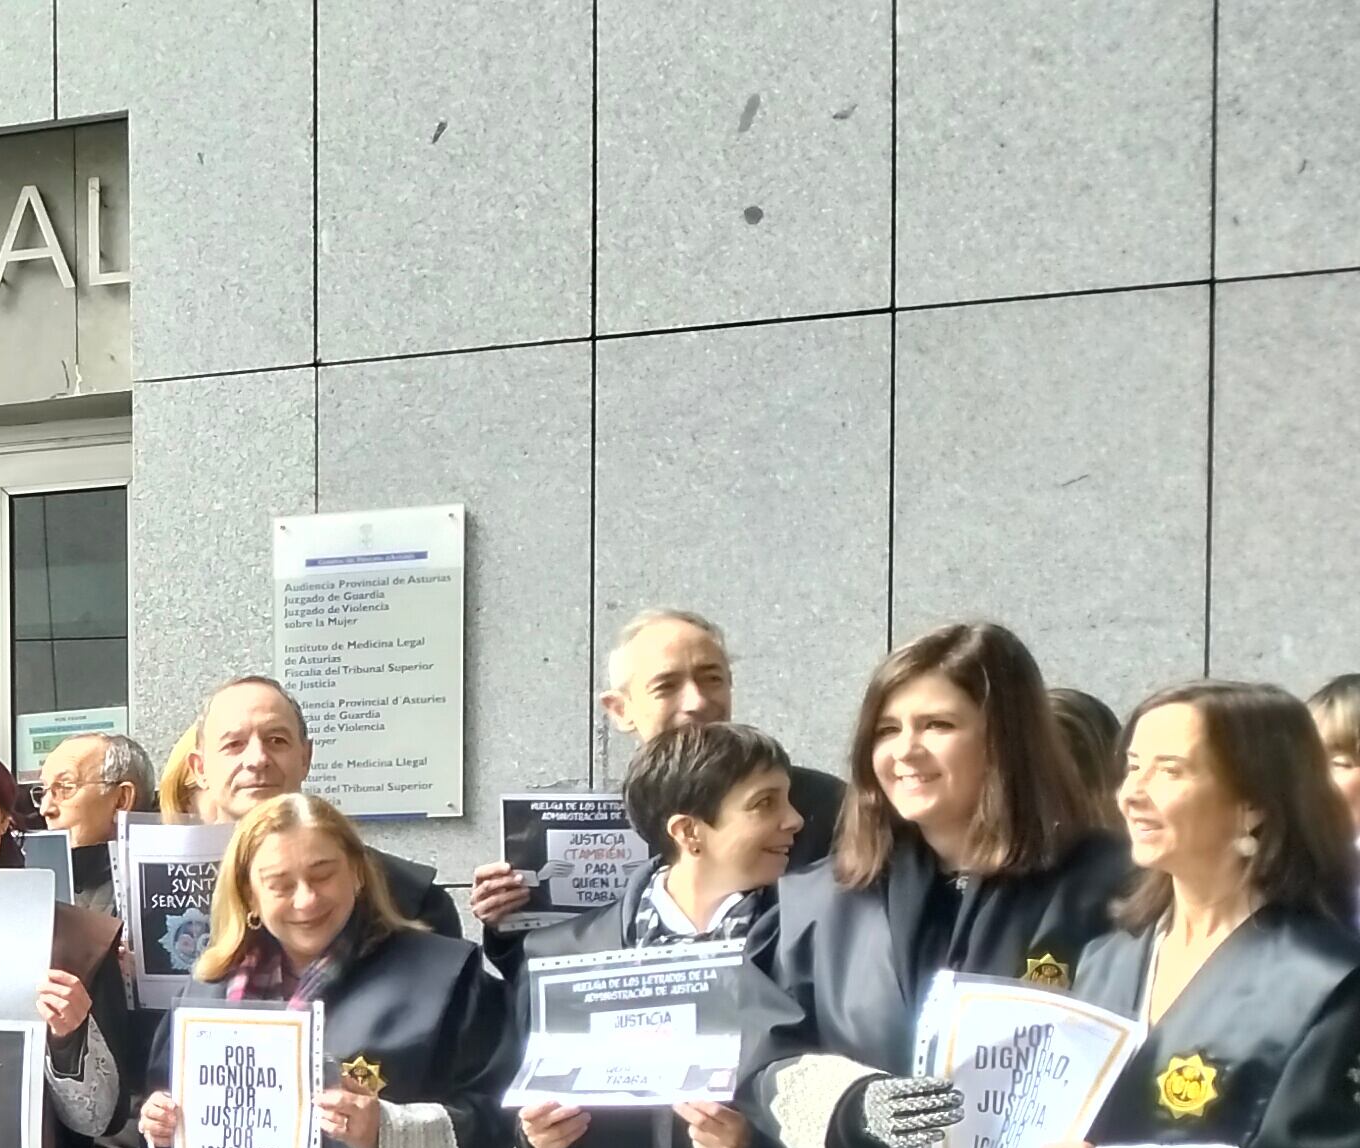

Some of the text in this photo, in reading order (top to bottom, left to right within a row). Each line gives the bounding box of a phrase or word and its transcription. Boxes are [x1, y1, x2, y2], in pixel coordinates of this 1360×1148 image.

[284, 574, 451, 592] Audiencia Provincial de Asturias
[284, 590, 385, 606] Juzgado de Guardia
[284, 602, 389, 618] Juzgado de Violencia
[285, 617, 357, 629] sobre la Mujer
[285, 637, 425, 653] Instituto de Medicina Legal
[285, 655, 341, 666] de Asturias
[325, 666, 340, 675] del
[343, 664, 384, 675] Tribunal
[388, 662, 434, 674] Superior
[284, 679, 336, 691] de Justicia
[339, 698, 388, 708] Provincial
[324, 711, 335, 721] de
[339, 711, 381, 720] Guardia
[324, 724, 336, 733] de
[338, 722, 385, 733] Violencia
[314, 738, 336, 747] uyer
[331, 760, 343, 770] de
[347, 757, 392, 768] Medicina
[396, 757, 427, 768] Llegal
[325, 784, 340, 793] del
[343, 783, 384, 793] Tribunal
[387, 782, 433, 793] Superior
[531, 801, 625, 811] HUELGA DE LOS LETRA
[610, 812, 622, 820] DE
[570, 833, 625, 848] JUSTICIA
[167, 863, 218, 877] PACTA
[585, 863, 617, 875] PARA
[171, 878, 216, 893] SUNT
[572, 877, 610, 889] QUIEN
[151, 894, 211, 909] SERVAN
[576, 891, 617, 902] TRABA
[572, 969, 718, 992] HUELGA DE LOS LETRADOS DE LA
[655, 985, 667, 996] DE
[669, 981, 709, 995] JUSTICIA
[614, 1011, 672, 1029] JUSTICIA
[1013, 1022, 1054, 1051] POR
[225, 1045, 256, 1067] POR
[975, 1044, 1070, 1087] DIGNIDAD,
[199, 1064, 283, 1092] DIGNIDAD,
[1011, 1068, 1042, 1100] POR
[225, 1086, 256, 1108] POR
[201, 1105, 278, 1133] JUSTICIA,
[223, 1126, 253, 1148] POR
